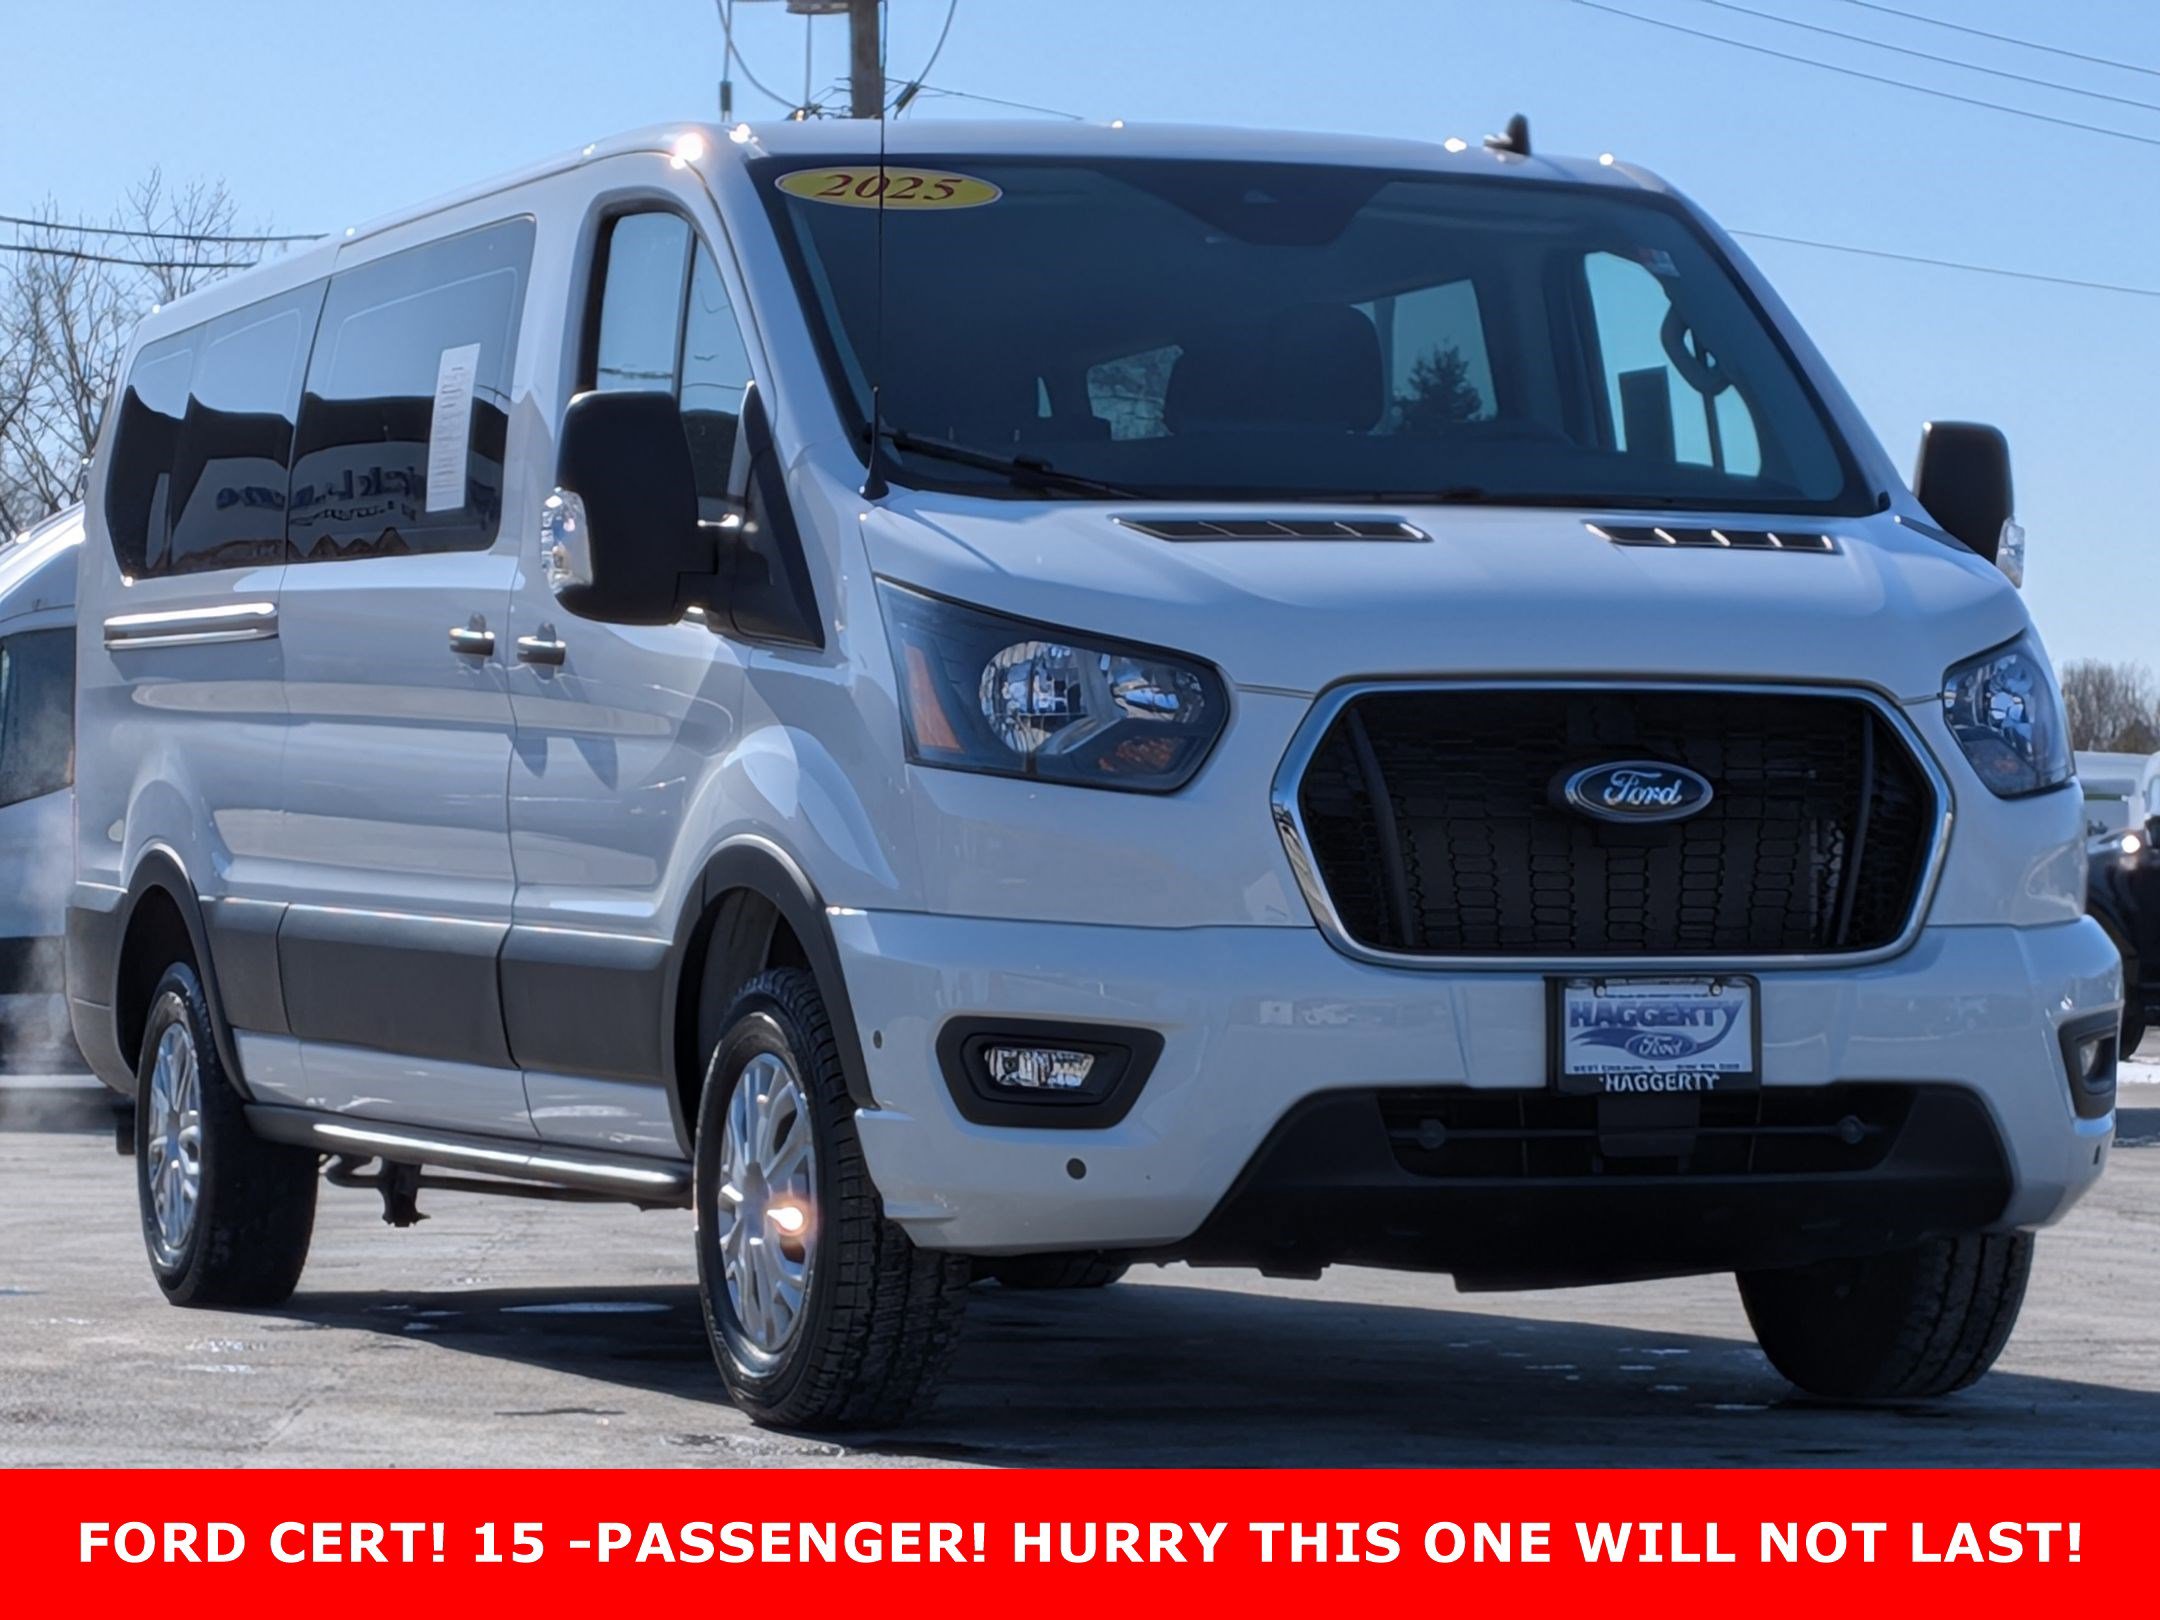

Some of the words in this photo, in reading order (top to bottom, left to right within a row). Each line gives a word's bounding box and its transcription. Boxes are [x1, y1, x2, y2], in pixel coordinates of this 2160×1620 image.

[816, 174, 963, 200] 2025
[1604, 769, 1682, 805] Ford
[1569, 1000, 1744, 1029] HAGGERTY
[1605, 1072, 1717, 1092] HAGGERTY
